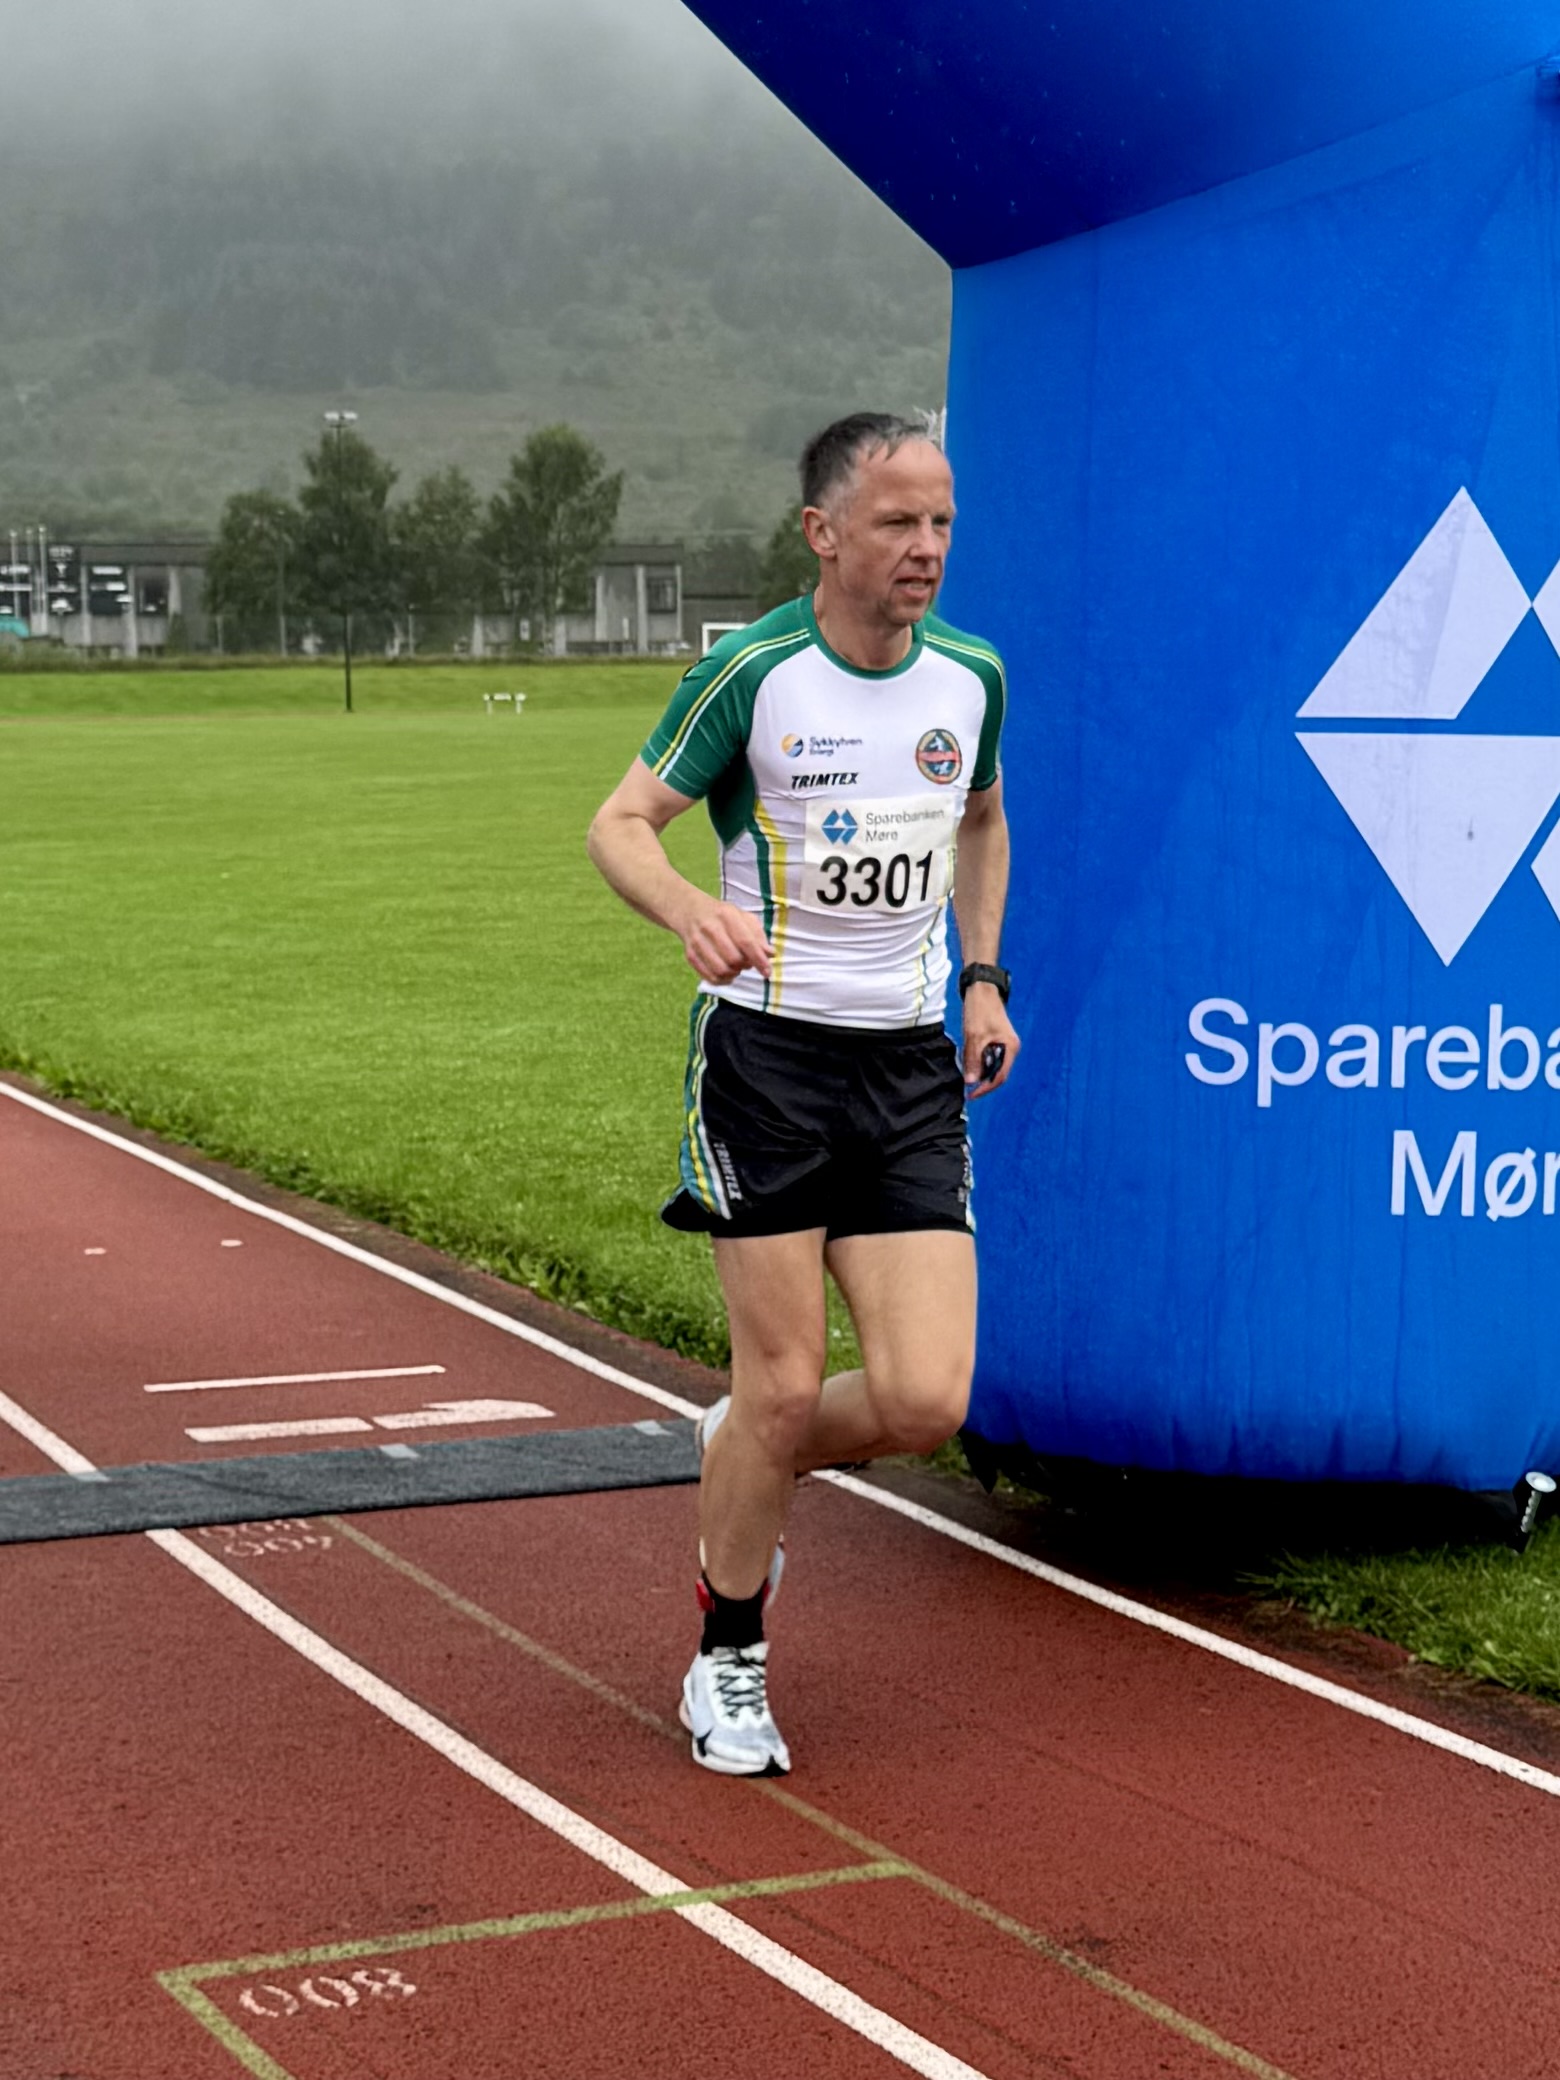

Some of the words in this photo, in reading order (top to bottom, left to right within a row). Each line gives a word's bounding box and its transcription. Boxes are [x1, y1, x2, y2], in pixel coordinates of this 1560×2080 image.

[791, 772, 859, 789] TRIMTEX
[865, 807, 945, 826] Sparebanken
[865, 830, 899, 843] Møre
[816, 850, 933, 908] 3301
